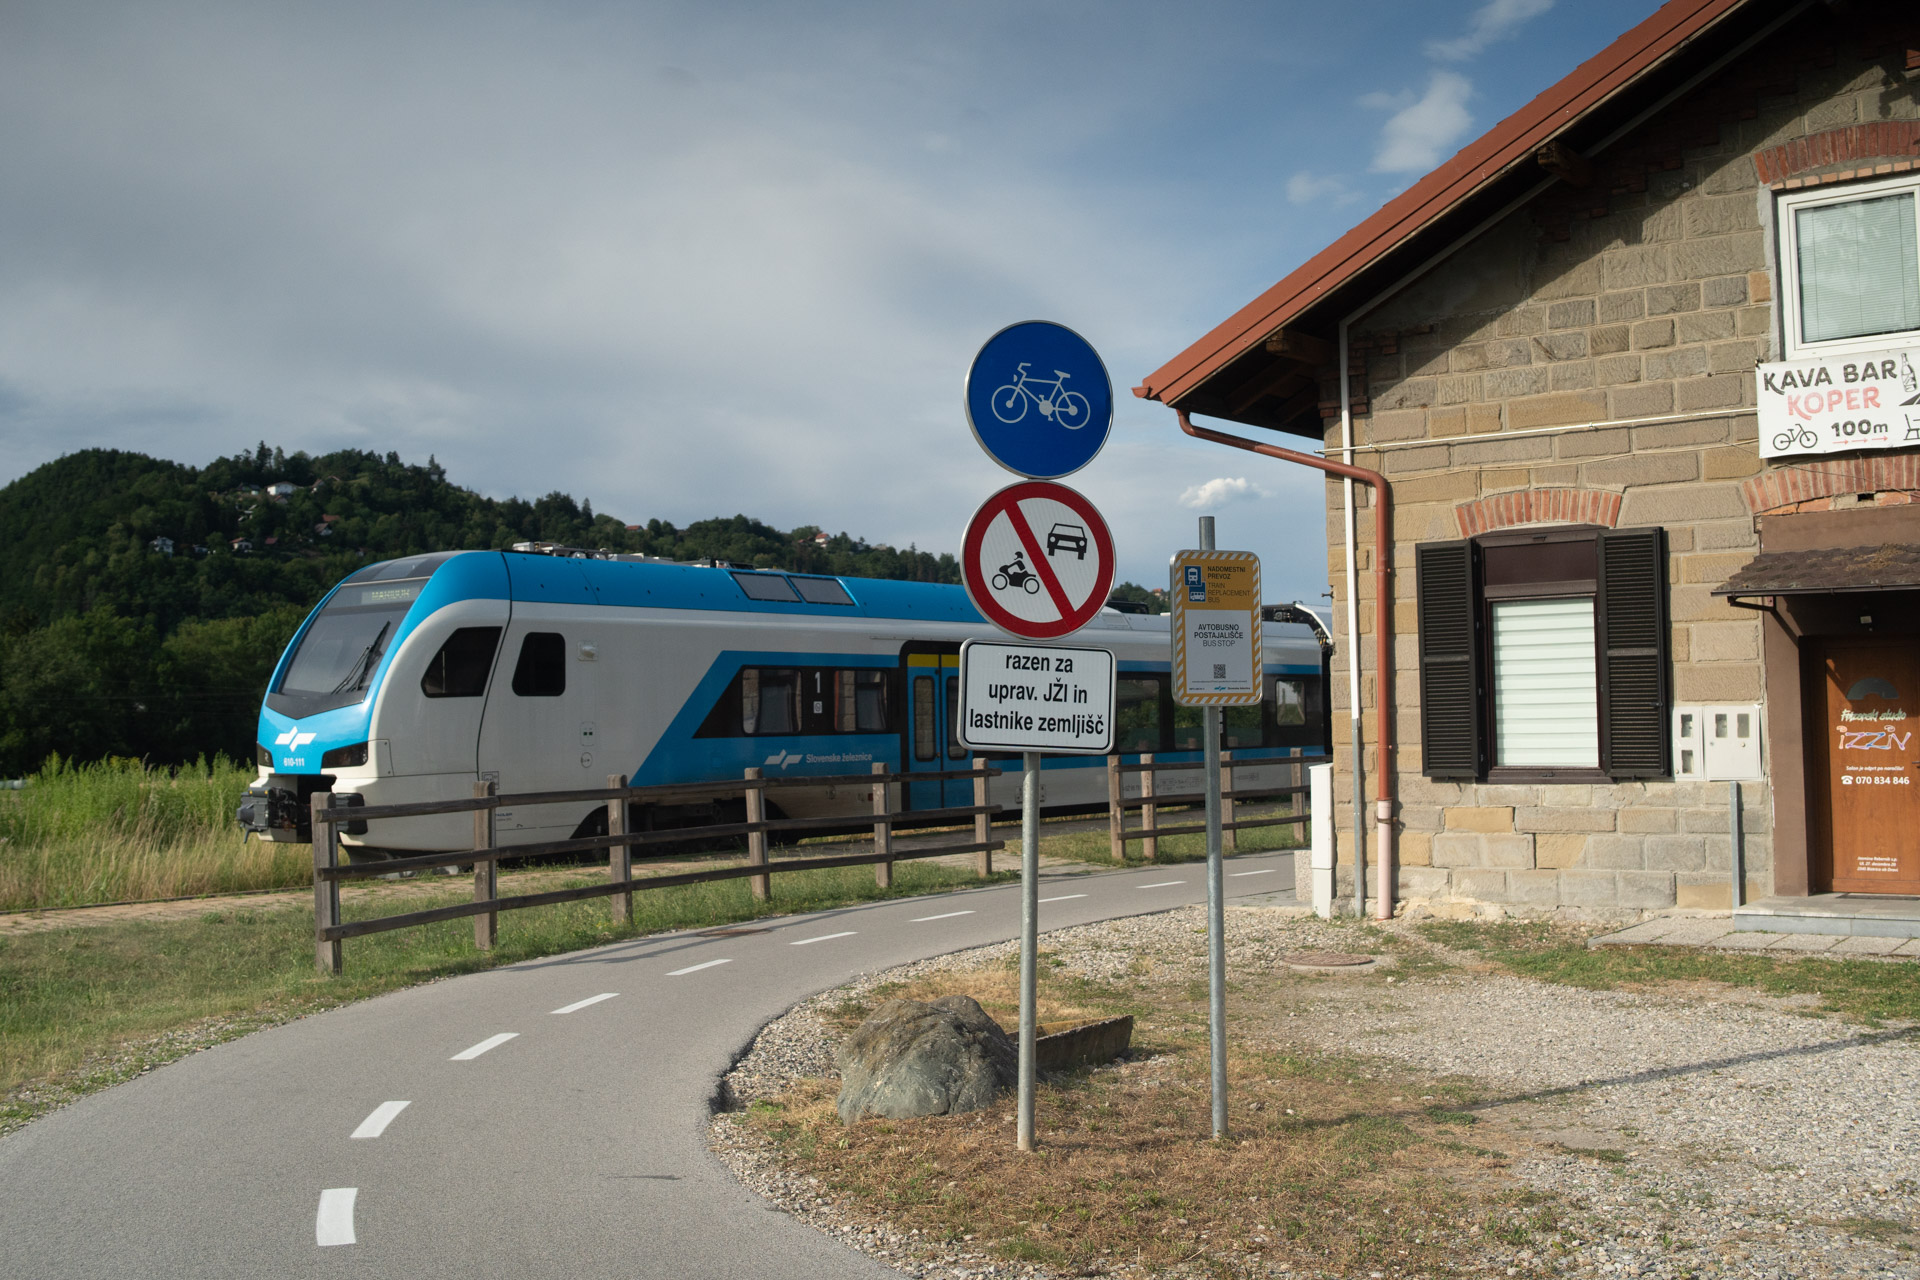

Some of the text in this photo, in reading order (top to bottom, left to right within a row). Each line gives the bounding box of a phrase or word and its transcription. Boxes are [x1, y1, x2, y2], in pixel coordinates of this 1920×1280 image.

[1763, 359, 1898, 395] KAVA BAR
[1787, 386, 1881, 421] KOPER
[1831, 419, 1889, 437] 100m
[1207, 589, 1250, 597] REPLACEMENT
[1194, 630, 1244, 639] POSTAJALIŠČE
[1006, 654, 1073, 673] razen za
[814, 671, 821, 693] 1
[989, 677, 1087, 704] uprav. JŽI in
[970, 708, 1104, 738] lastnike zemljišč
[283, 757, 305, 767] 610-111
[806, 751, 873, 763] Slovenske železnice
[1855, 776, 1910, 784] 070 834 846
